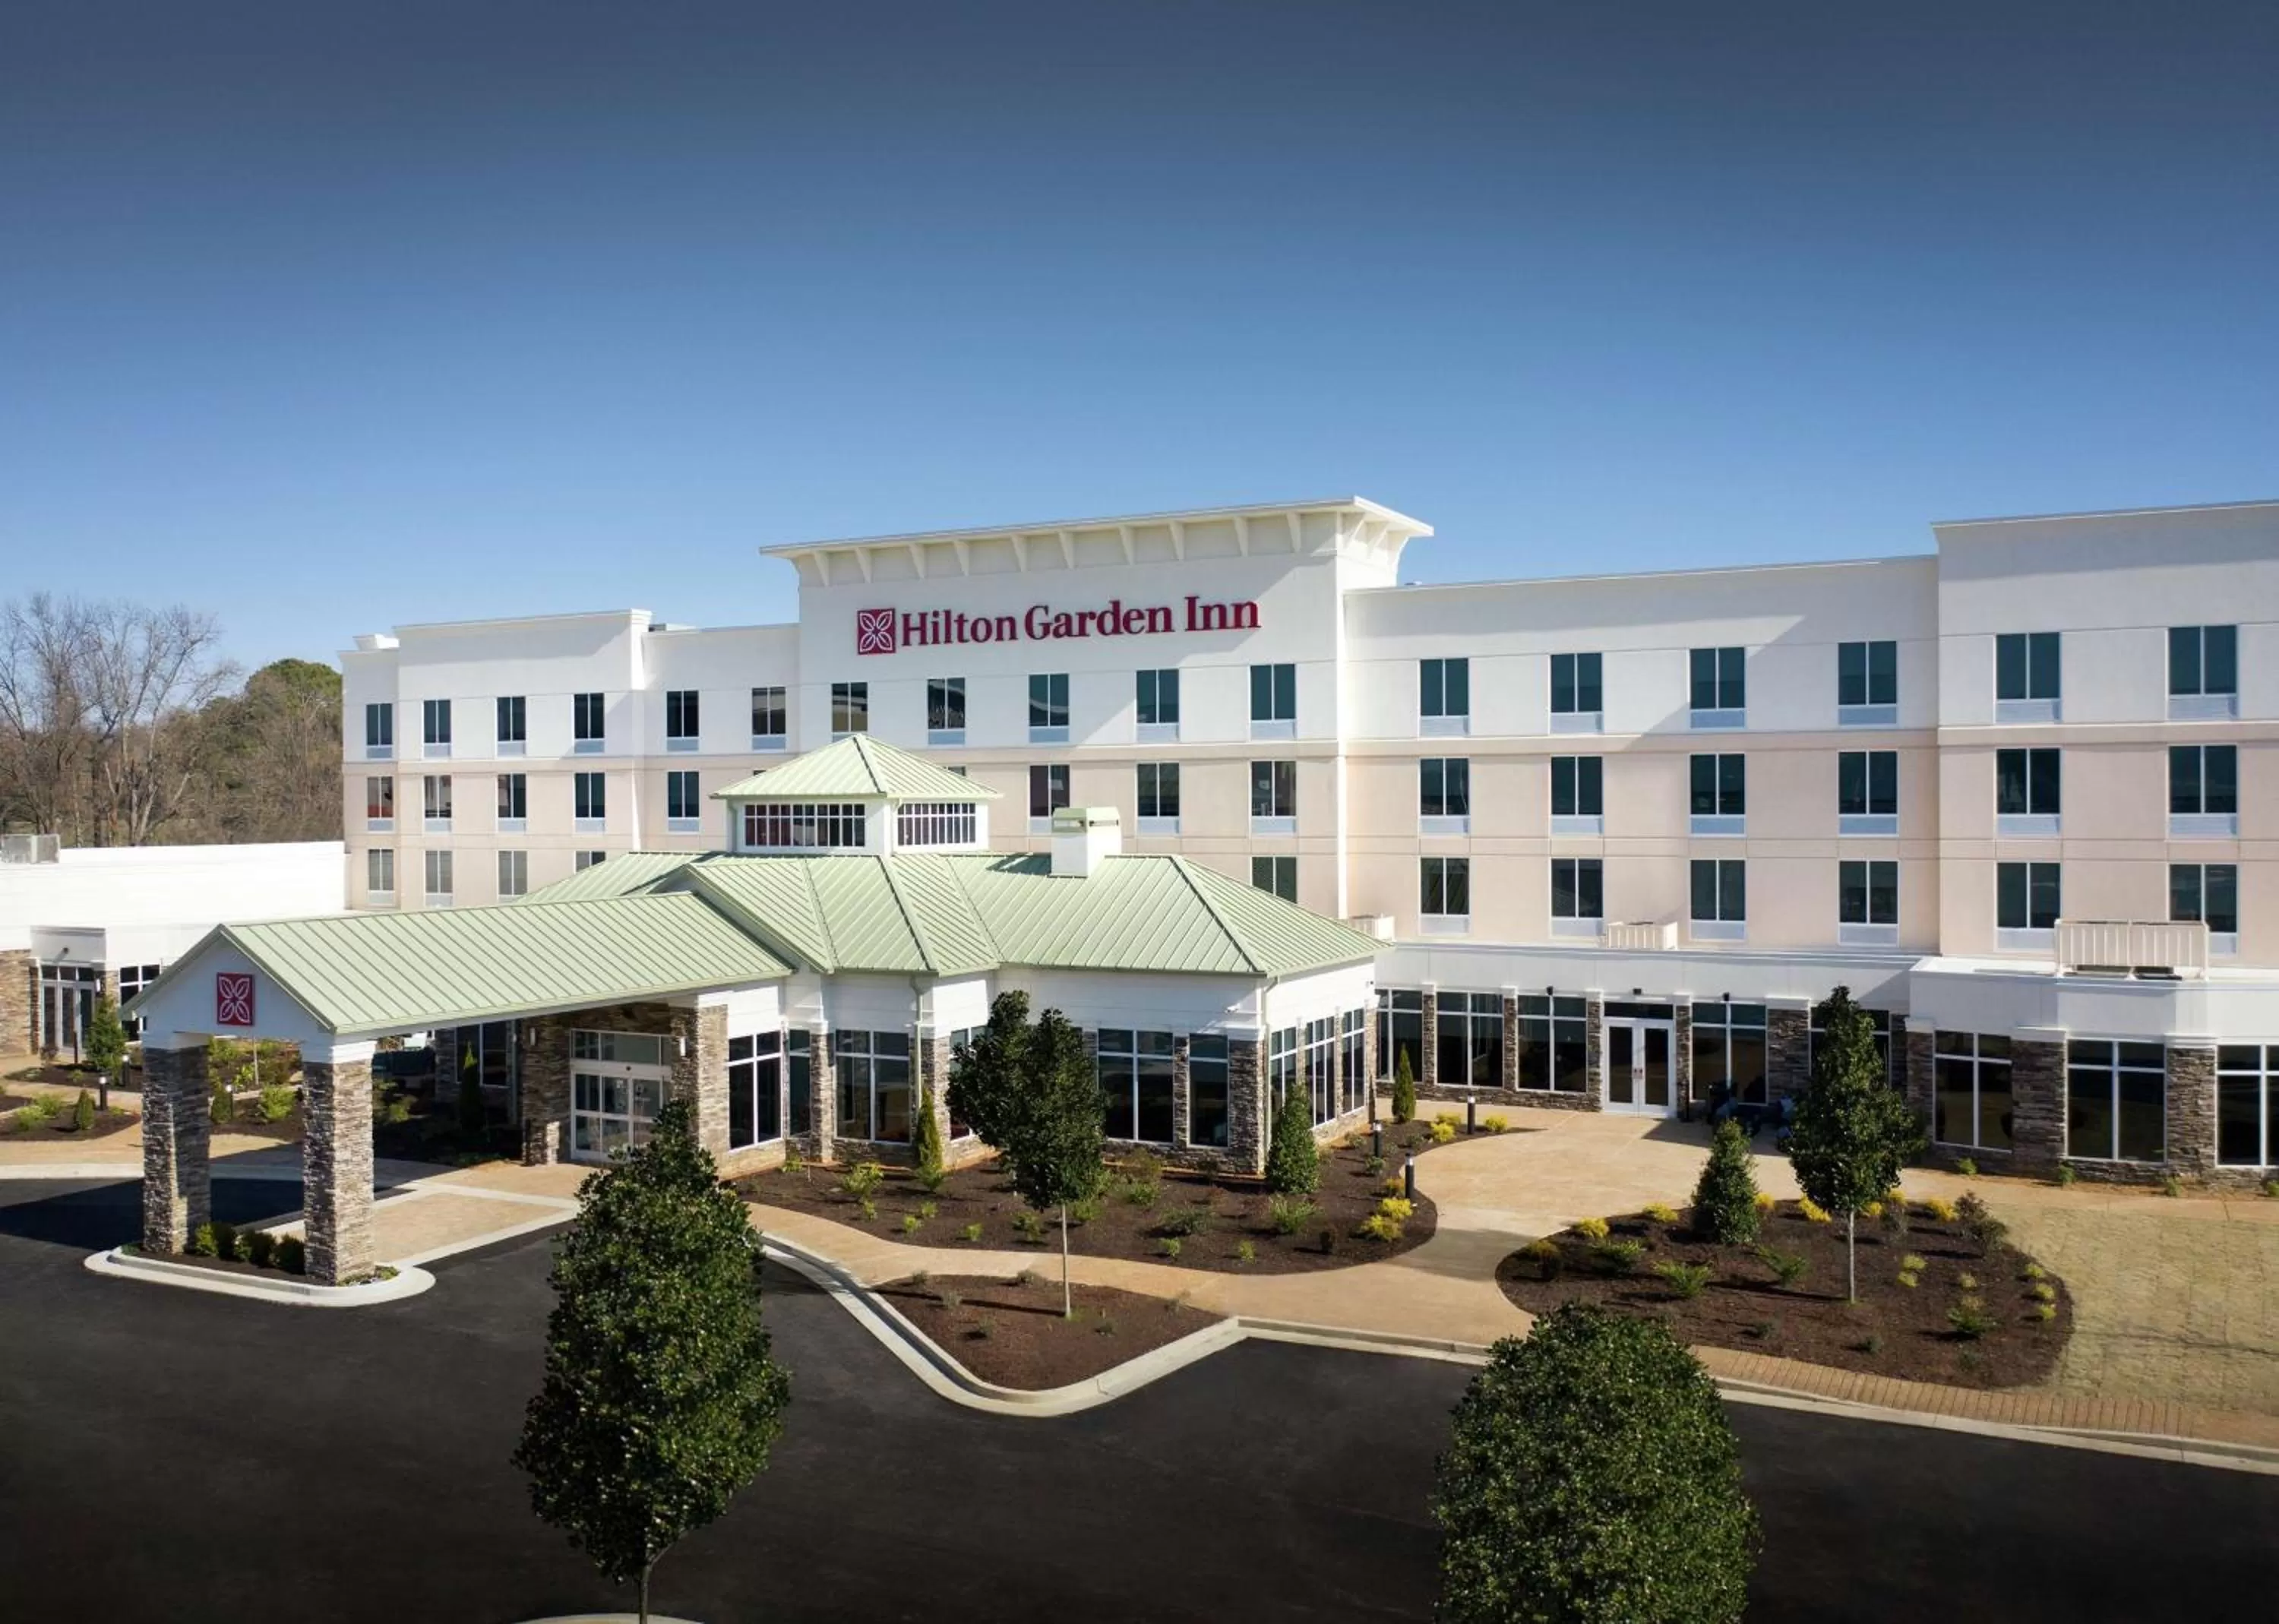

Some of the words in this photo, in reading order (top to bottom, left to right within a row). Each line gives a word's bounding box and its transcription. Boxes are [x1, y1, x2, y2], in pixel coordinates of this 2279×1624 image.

[901, 609, 1018, 646] Hilton
[1024, 600, 1174, 640] Garden
[1184, 596, 1262, 632] Inn
